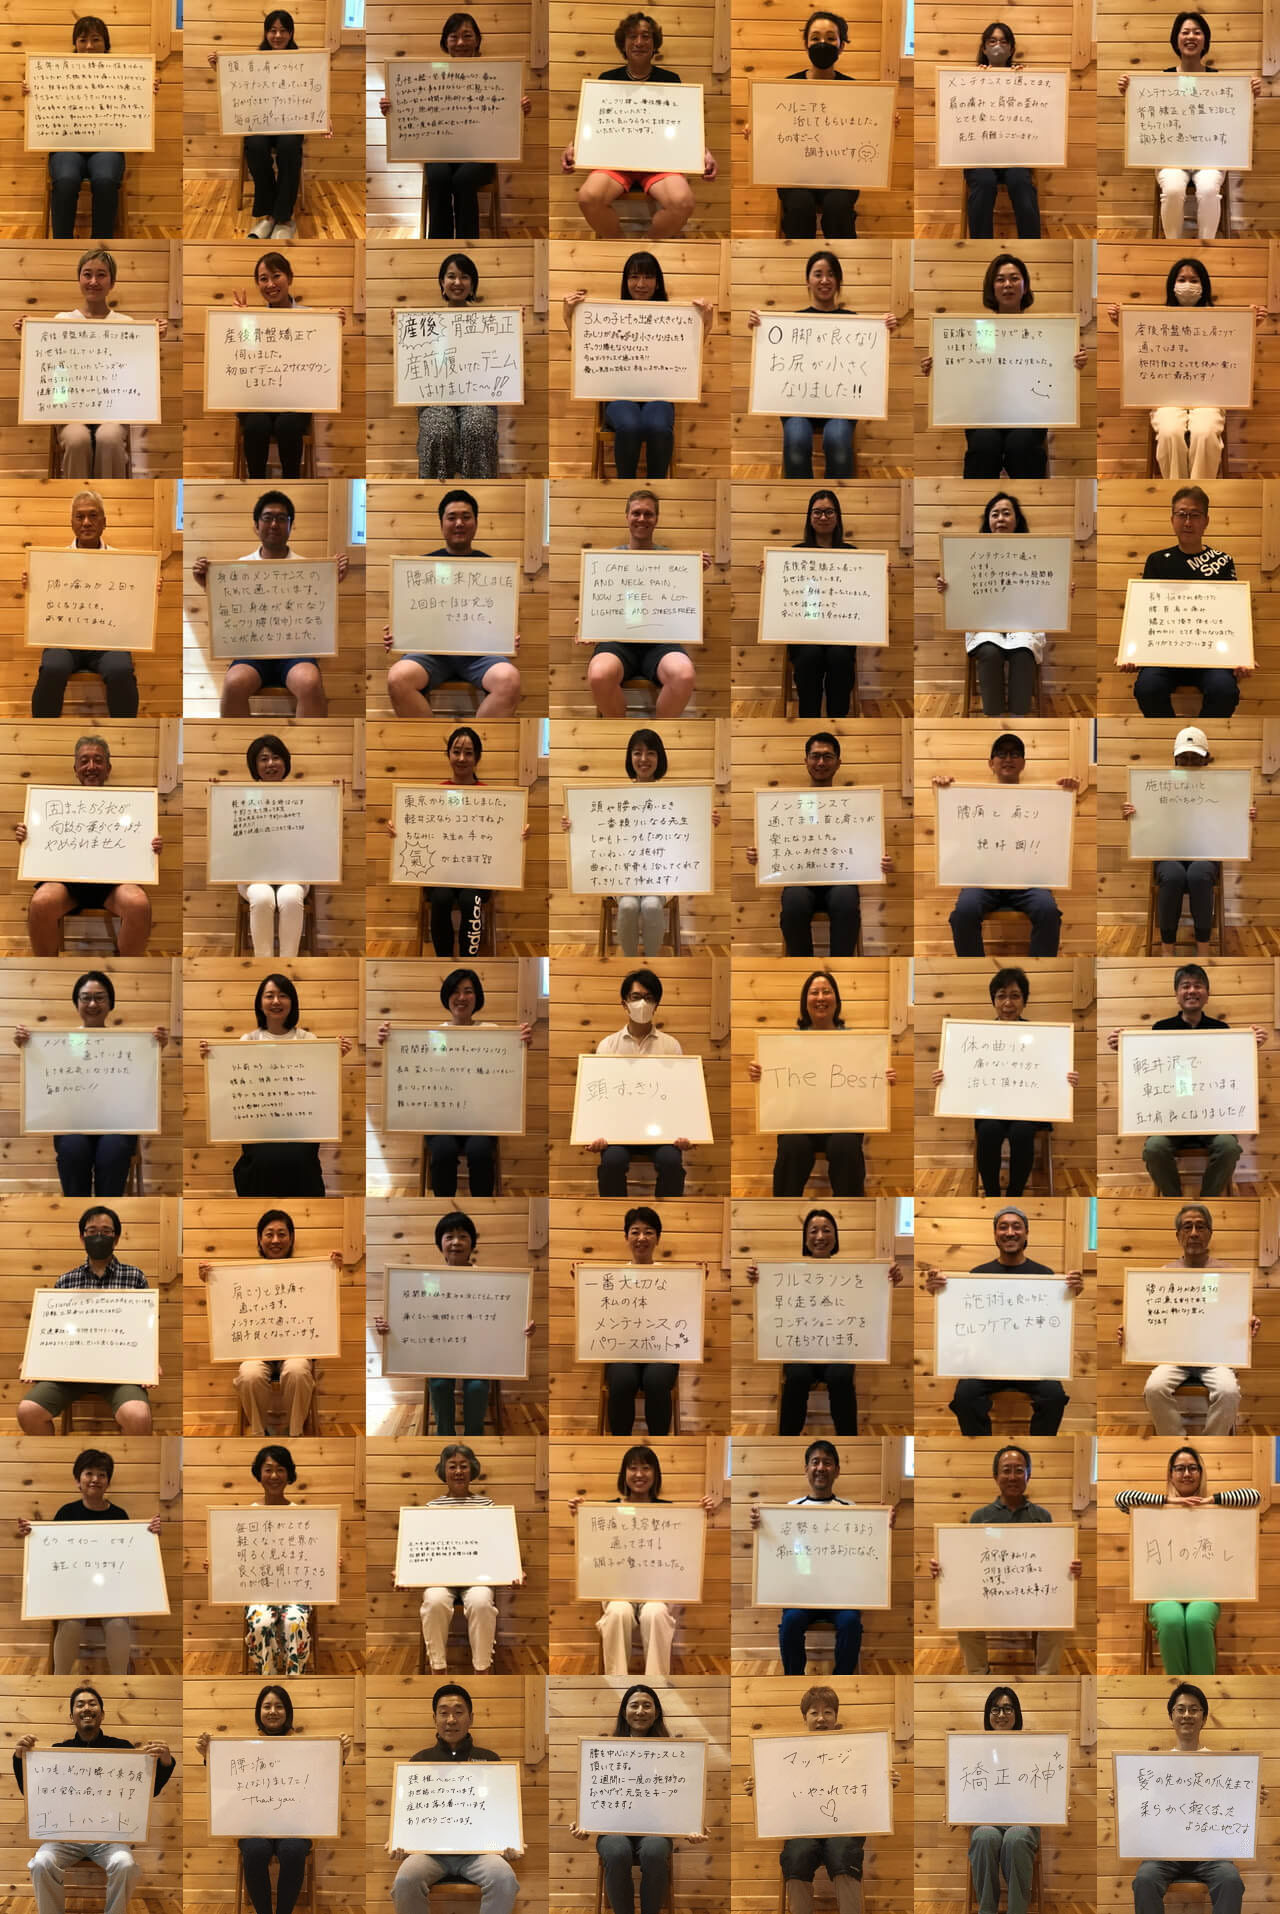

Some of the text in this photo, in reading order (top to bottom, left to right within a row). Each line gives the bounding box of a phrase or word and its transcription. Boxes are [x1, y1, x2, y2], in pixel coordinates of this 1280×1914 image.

[776, 102, 825, 113] ヘルニアを
[403, 313, 515, 341] 産後 骨盤矯正
[225, 327, 318, 344] 産後骨盤矯正で
[769, 353, 868, 376] お尻が小さく
[592, 561, 599, 576] I
[606, 563, 630, 573] CAME
[636, 565, 661, 573] WITH
[594, 579, 615, 588] AND
[592, 592, 612, 601] NOW
[616, 593, 625, 602] I
[628, 593, 654, 601] FEEL
[632, 607, 649, 616] AND
[468, 895, 481, 955] adidas
[764, 1063, 885, 1089] The Best
[584, 1272, 667, 1291] 一番大切な
[772, 1271, 864, 1289] フルマラソンを
[600, 1295, 648, 1310] 私の体
[775, 1295, 847, 1309] 早く走る為に
[594, 1316, 688, 1331] メンテナンスの
[773, 1315, 866, 1328] コンディショニングを
[590, 1335, 674, 1352] パワースポット
[783, 1748, 852, 1768] マッサージ
[959, 1760, 1056, 1794] 矯正の神
[792, 1784, 868, 1799] いやされてます
[242, 1795, 296, 1811] Thank you
